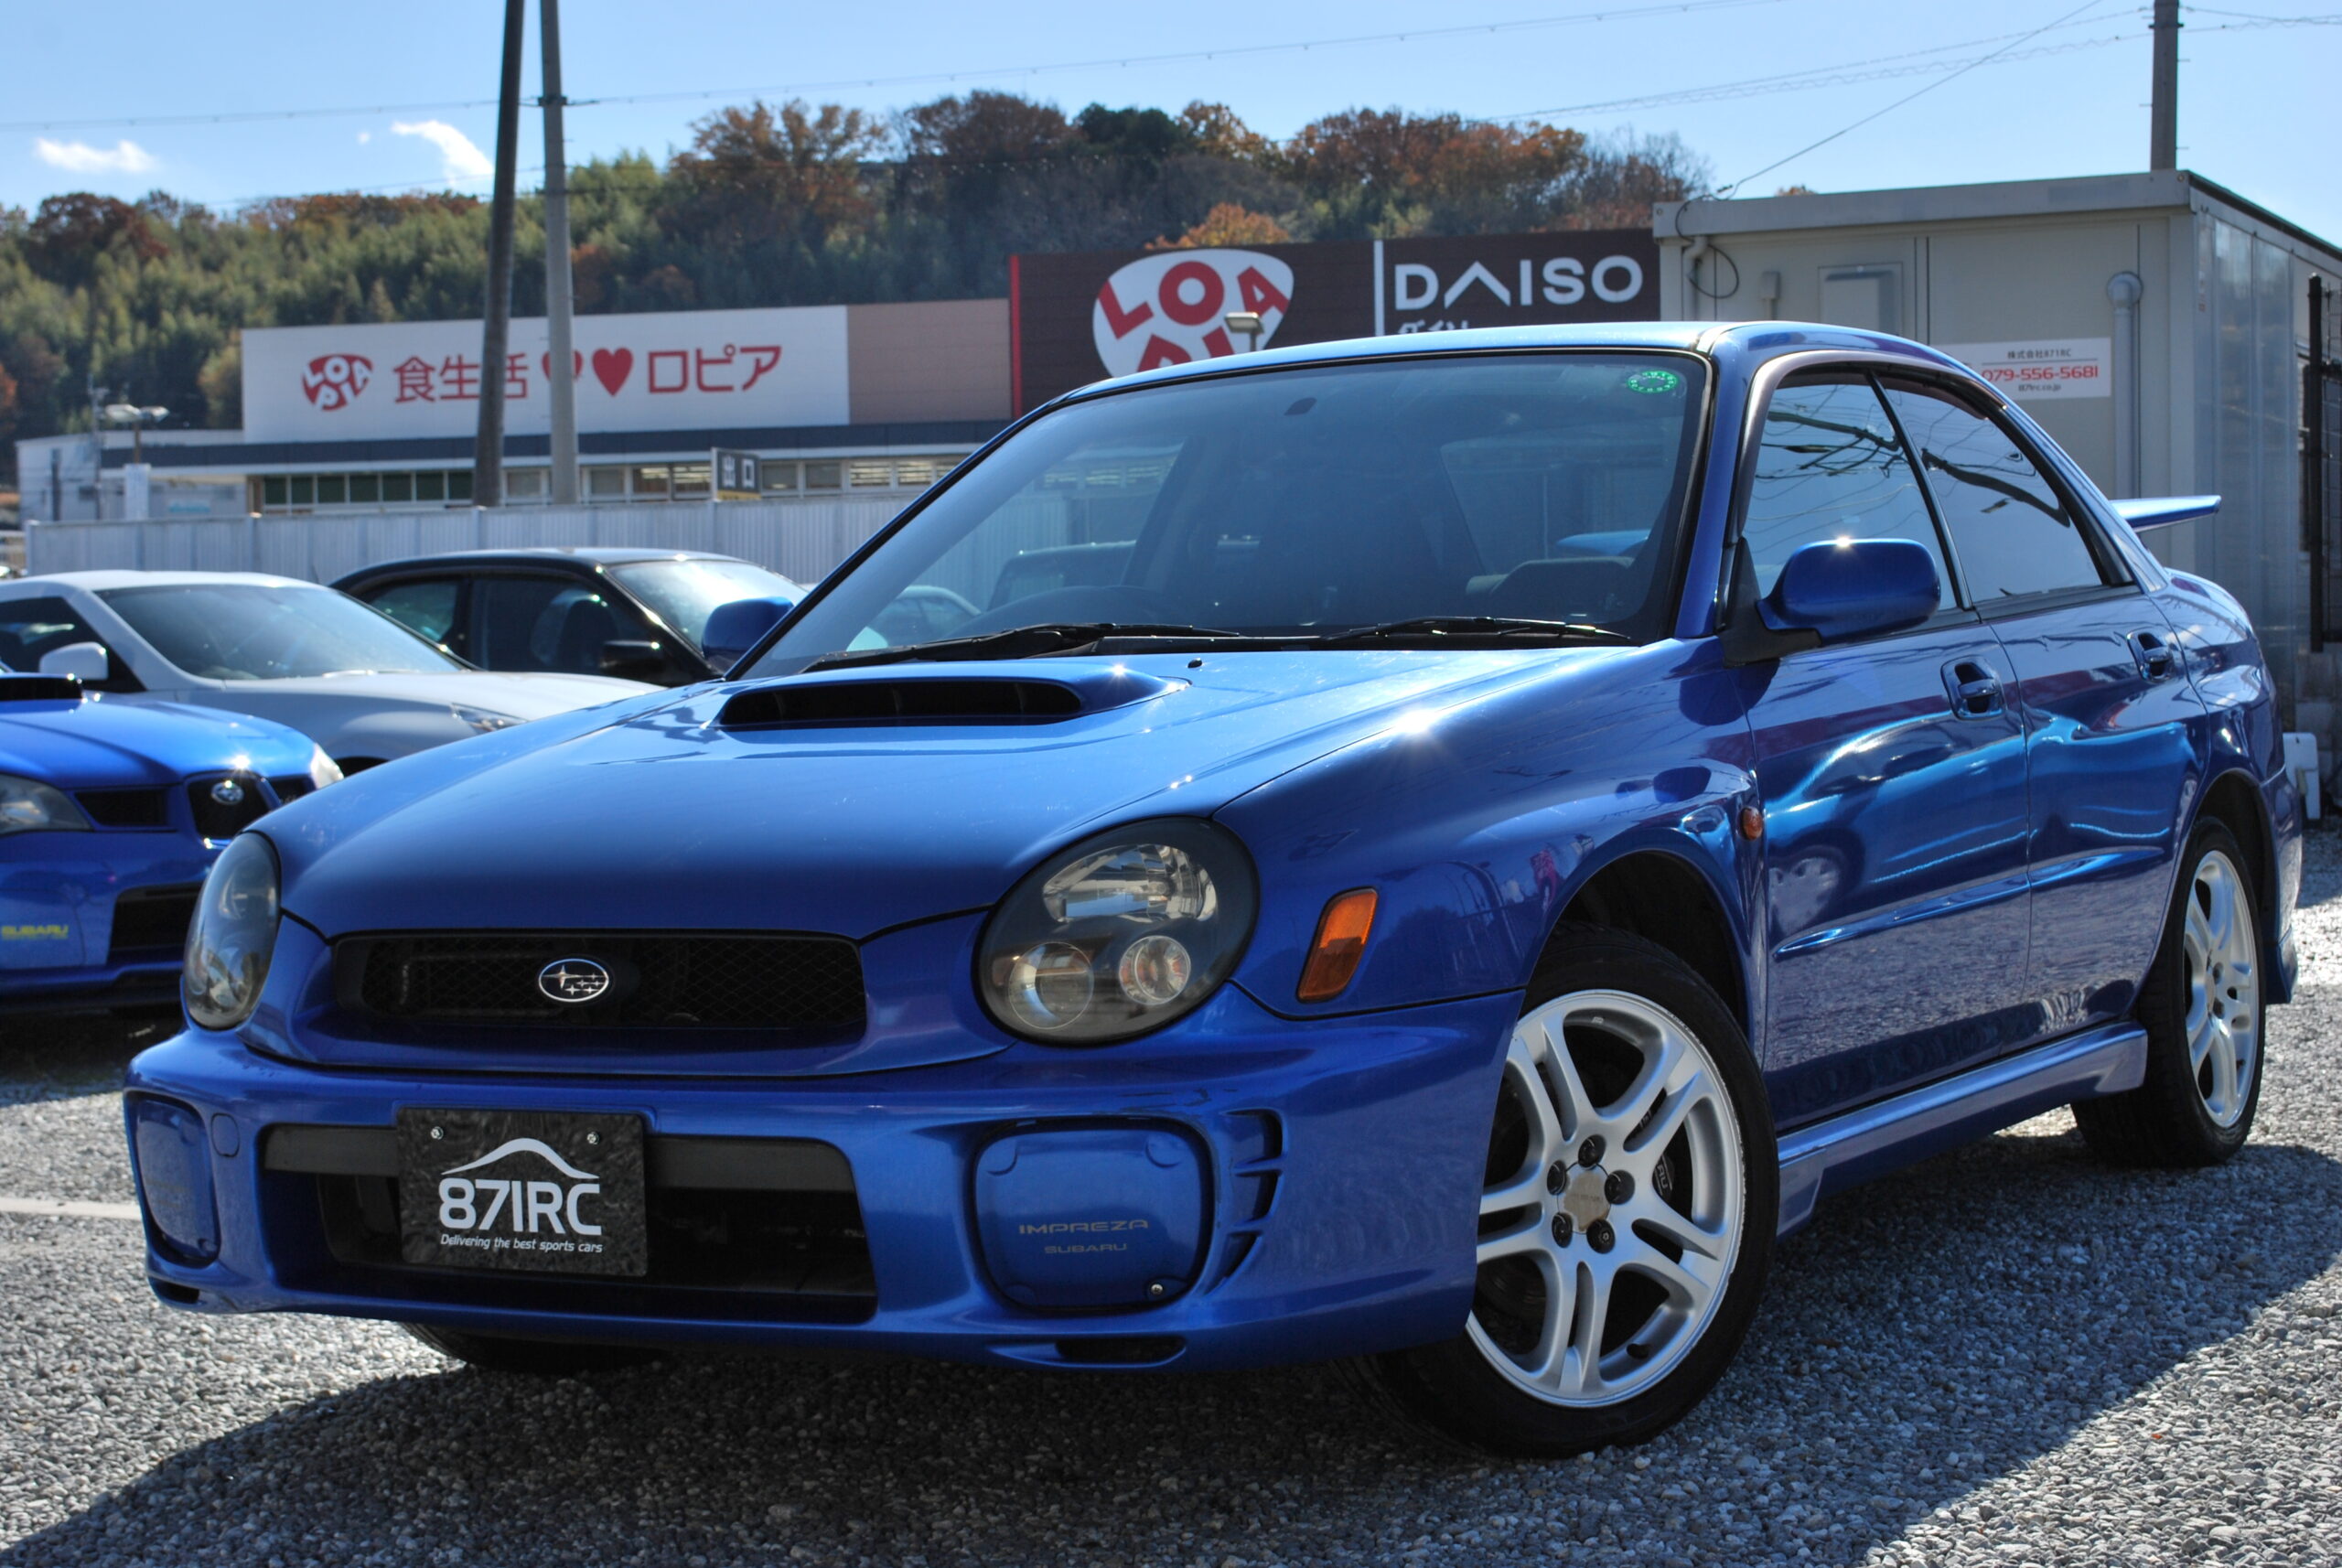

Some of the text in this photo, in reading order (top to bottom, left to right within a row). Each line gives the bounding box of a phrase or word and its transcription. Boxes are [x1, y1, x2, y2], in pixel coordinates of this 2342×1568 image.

[1395, 254, 1643, 310] DAISO
[649, 344, 782, 394] ロピア
[1982, 365, 2099, 381] 079-556-5681
[2, 924, 69, 936] SUBARU
[1019, 1219, 1149, 1234] IMPREZA
[440, 1234, 603, 1253] Delivering the best sports cars
[1045, 1243, 1127, 1254] SUBARU
